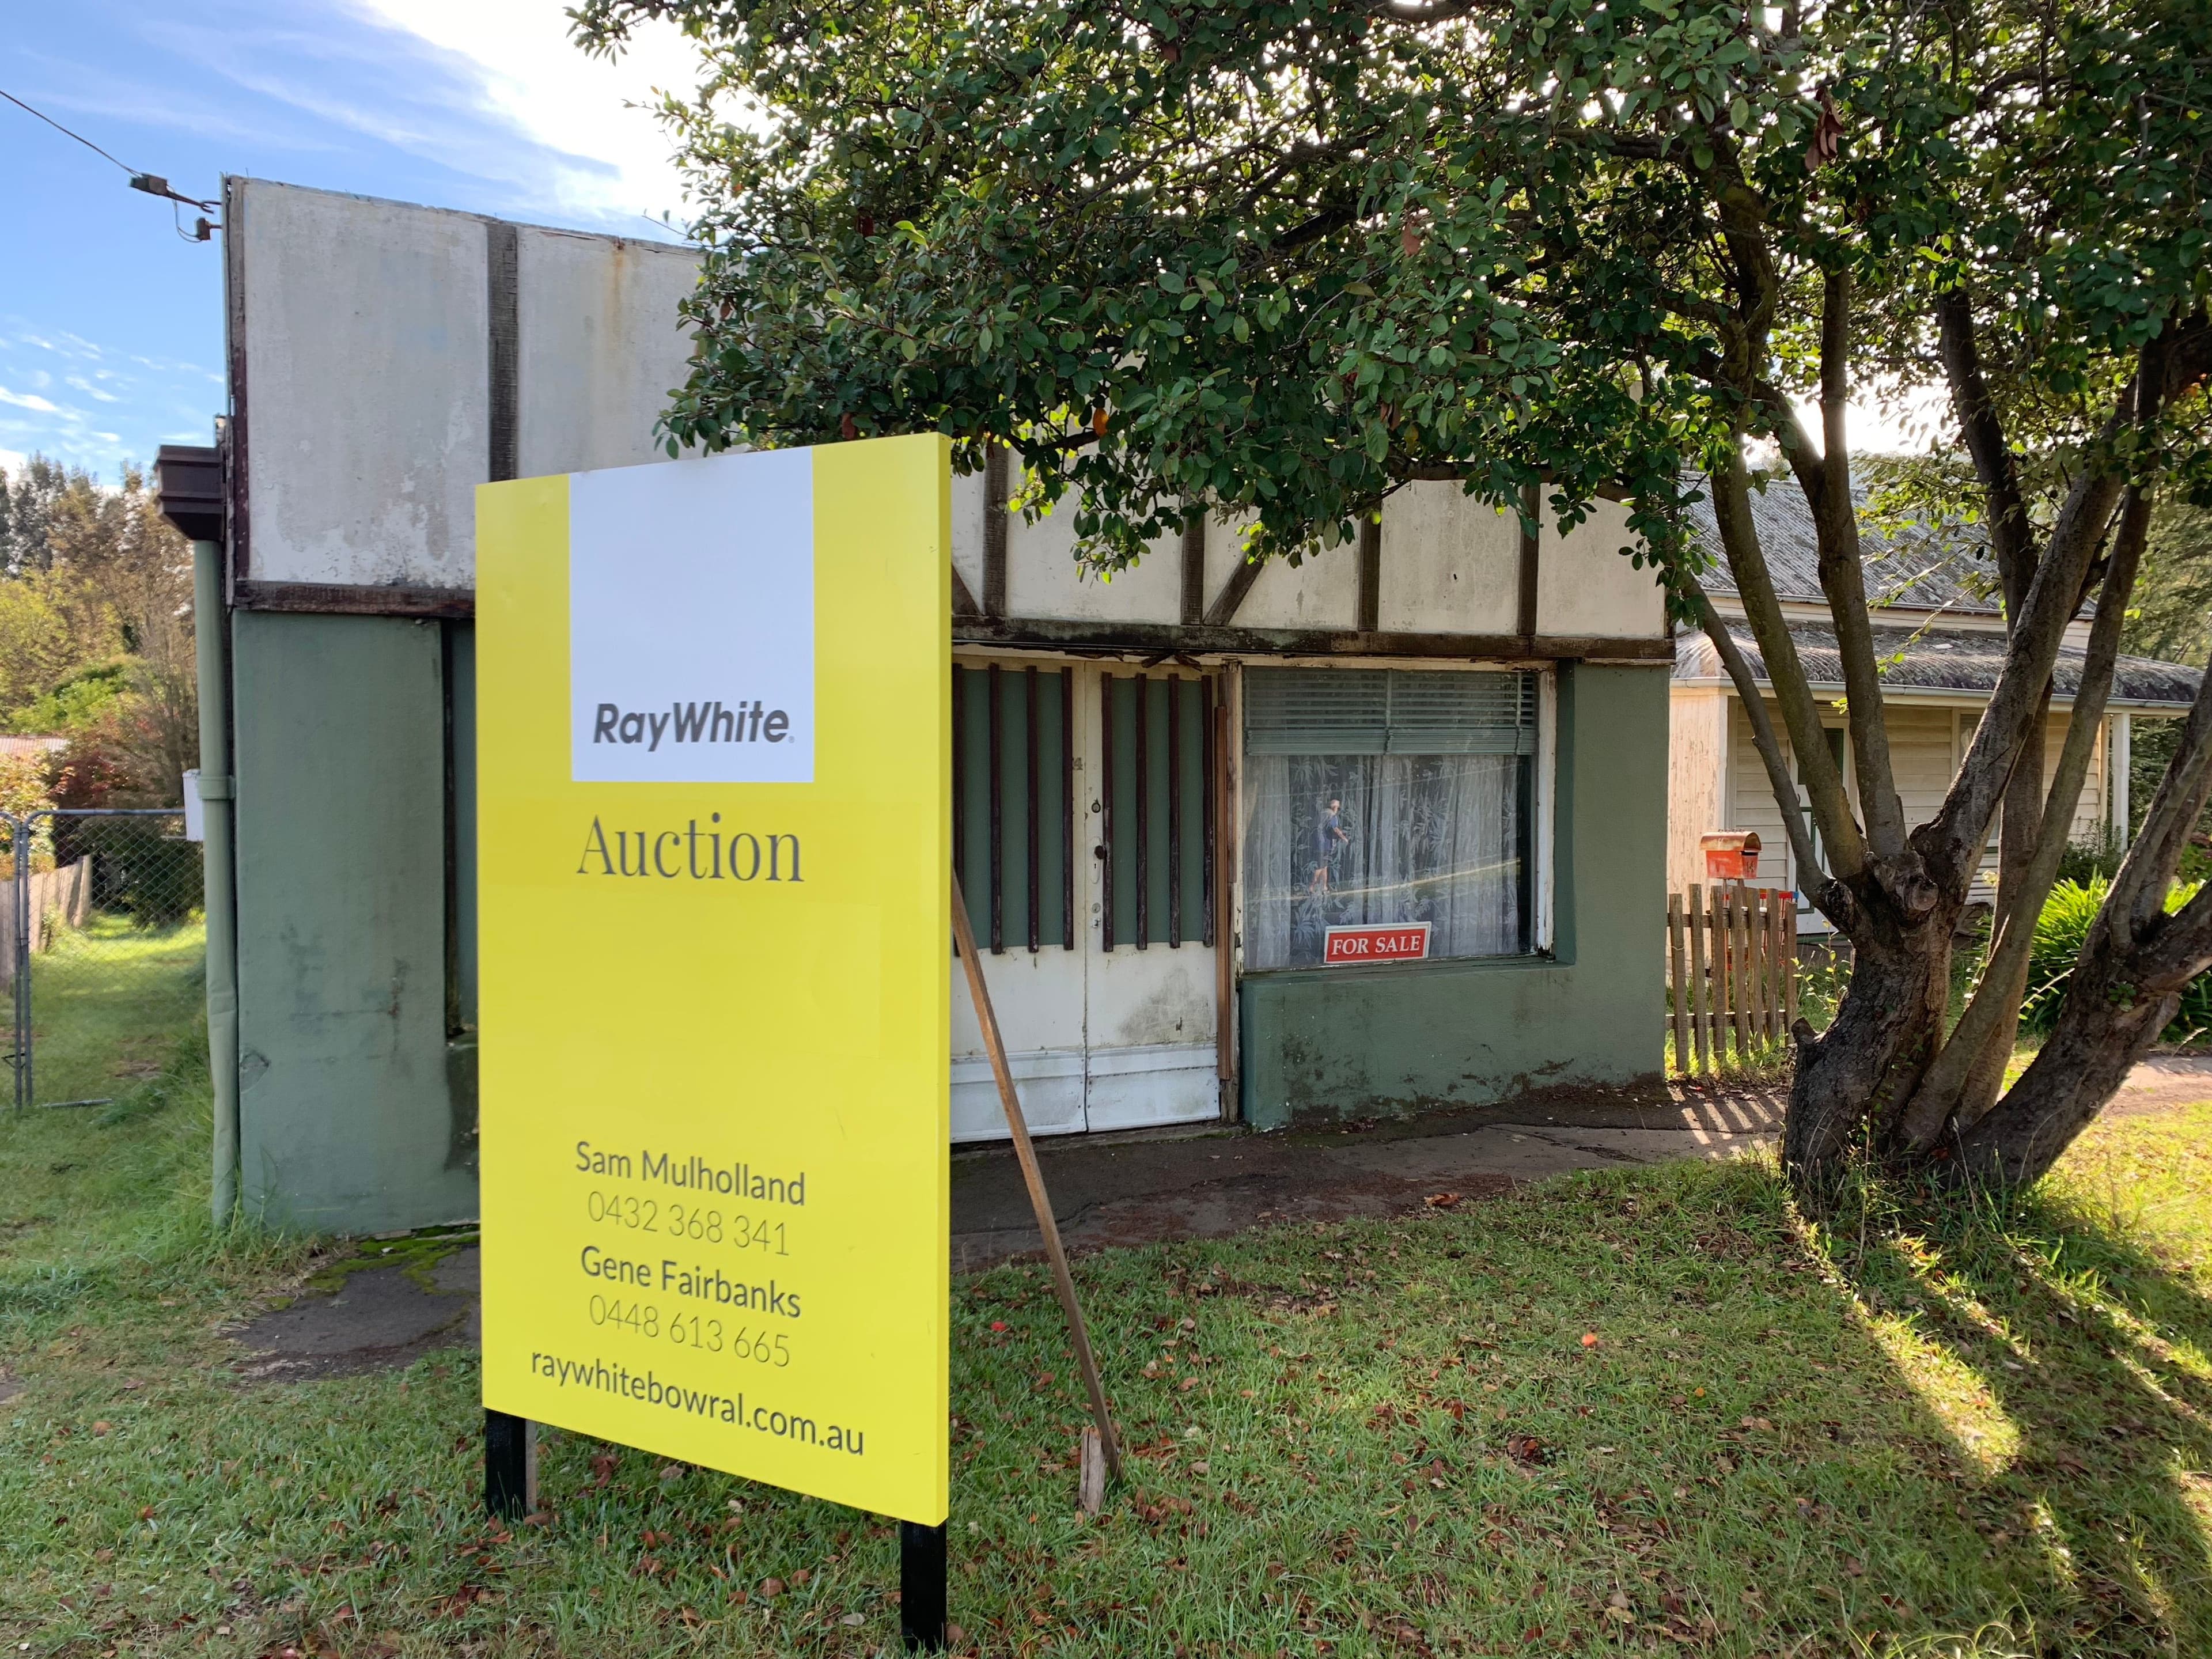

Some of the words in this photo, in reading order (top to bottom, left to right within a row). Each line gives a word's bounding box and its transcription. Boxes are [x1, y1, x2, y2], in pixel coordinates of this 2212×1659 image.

[576, 812, 805, 882] Auction
[1331, 938, 1369, 955] FOR
[1375, 935, 1421, 953] SALE
[575, 1141, 631, 1179] Sam
[642, 1150, 805, 1206] Mulholland
[588, 1191, 658, 1233] 0432
[668, 1204, 724, 1244] 368
[734, 1215, 790, 1256] 341
[581, 1245, 652, 1288] Gene
[661, 1259, 801, 1319] Fairbanks
[589, 1294, 660, 1338] 0448
[669, 1312, 724, 1353] 613
[734, 1327, 790, 1368] 665
[532, 1351, 864, 1456] raywhitebowral.com.au
